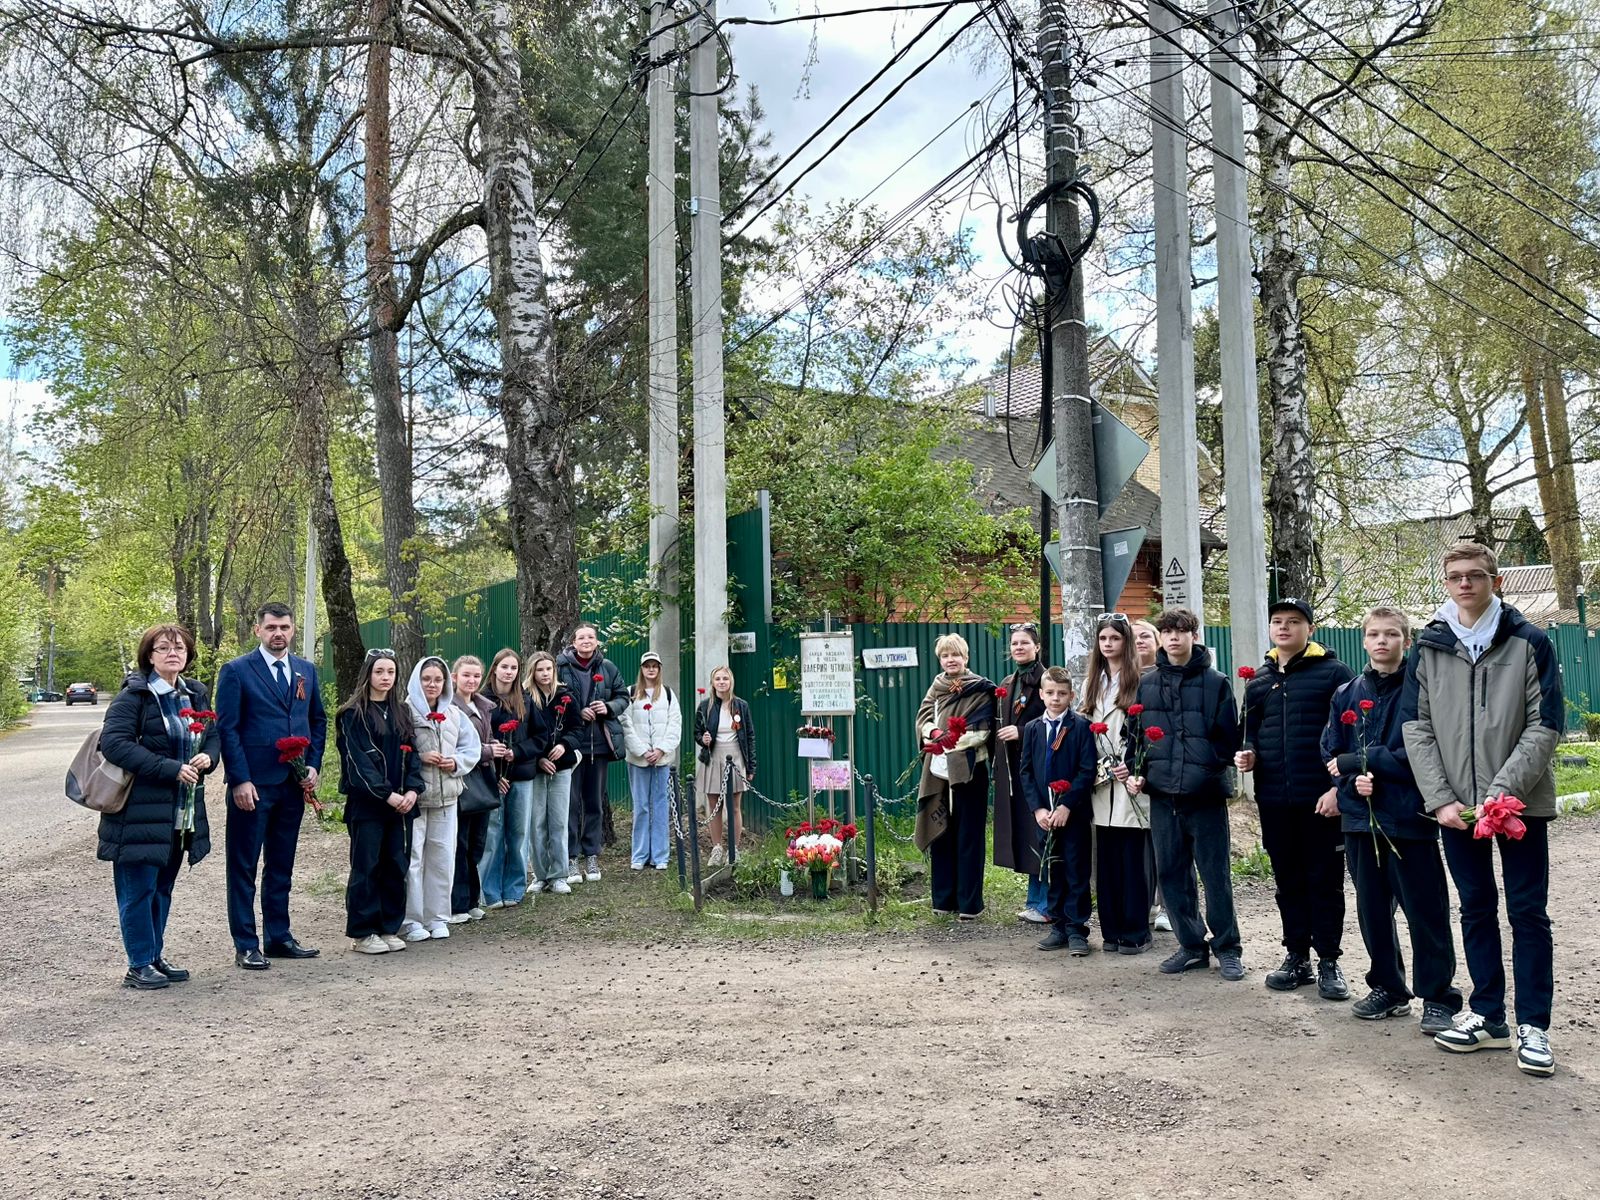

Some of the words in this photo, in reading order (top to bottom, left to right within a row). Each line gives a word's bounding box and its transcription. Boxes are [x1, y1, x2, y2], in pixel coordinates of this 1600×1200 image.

[886, 653, 907, 662] УТКИНА
[803, 663, 828, 673] ВАЛЕРИЯ
[830, 663, 852, 673] УТКИНА
